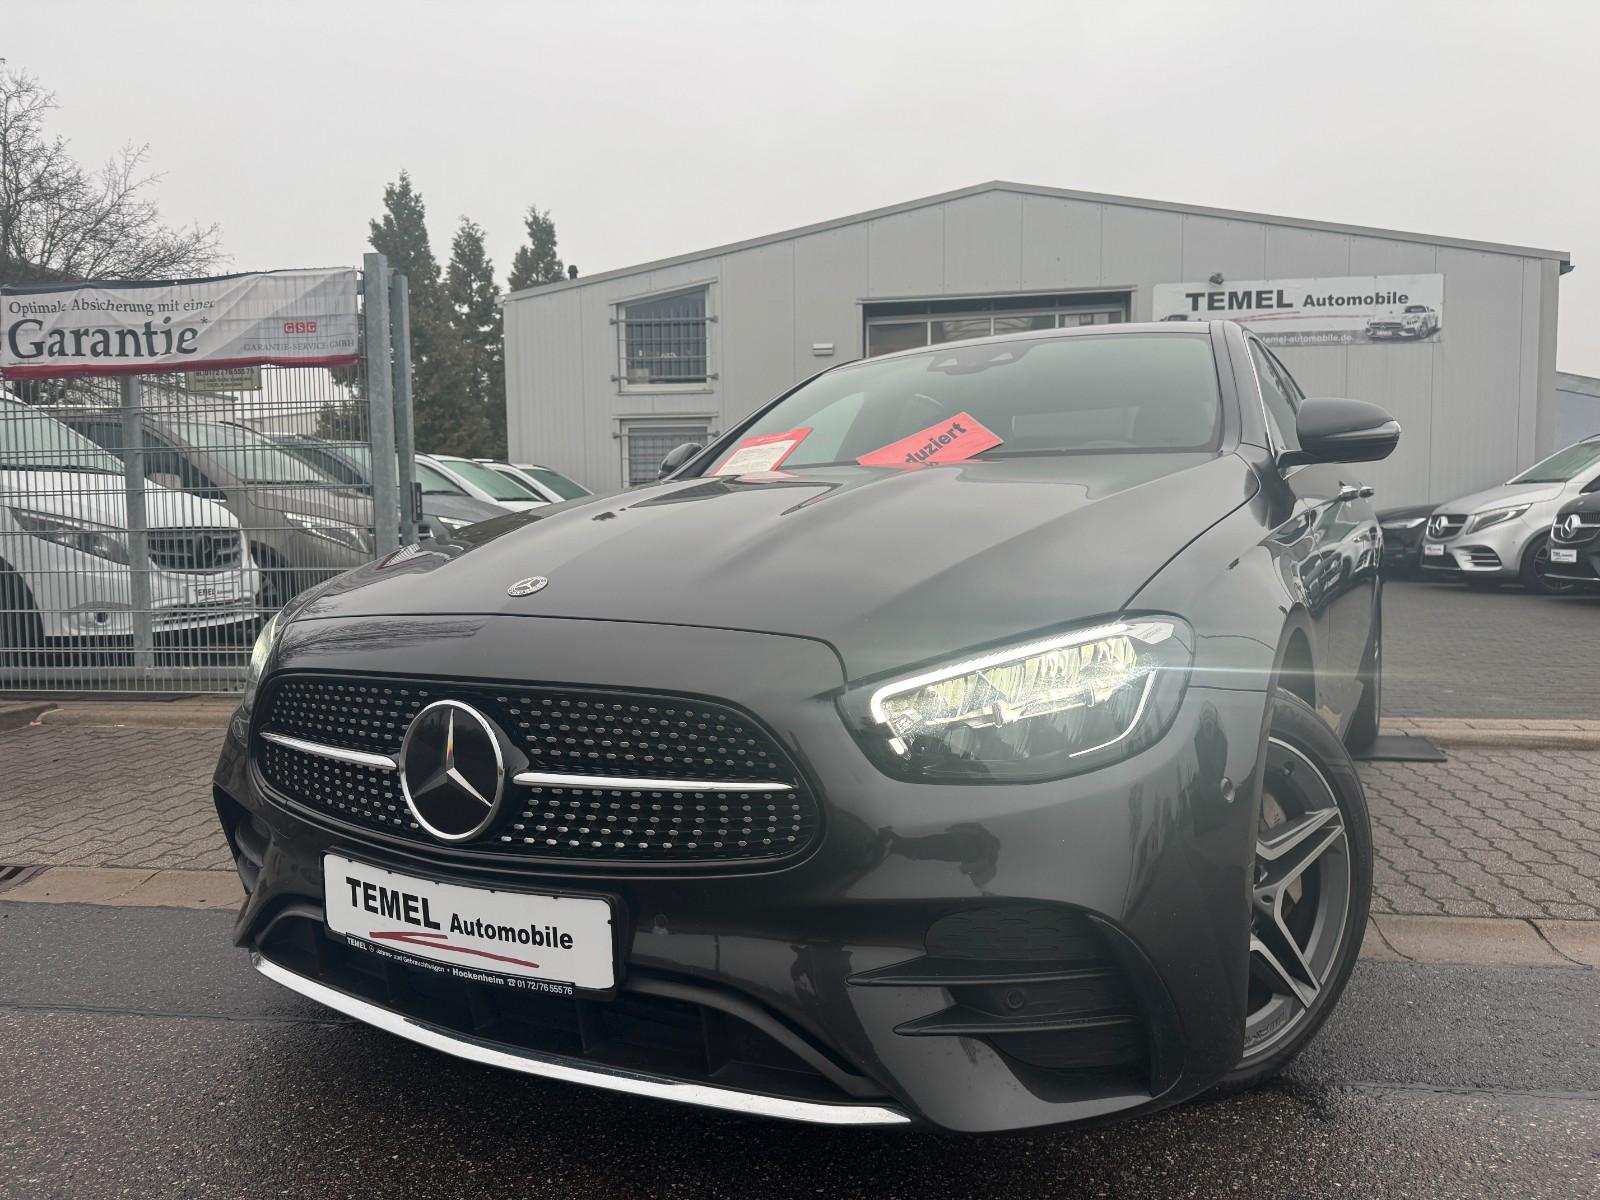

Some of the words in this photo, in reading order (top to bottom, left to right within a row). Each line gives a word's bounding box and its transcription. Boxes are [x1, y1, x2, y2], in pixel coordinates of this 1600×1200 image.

[9, 300, 67, 318] Optimale
[71, 297, 154, 316] Absicherung
[157, 299, 180, 312] mit
[1185, 290, 1294, 312] TEMEL
[1302, 292, 1409, 307] Automobile
[345, 876, 441, 930] TEMEL
[449, 912, 574, 950] Automobile
[347, 937, 368, 951] TEMEL
[452, 967, 504, 985] Hockenheim
